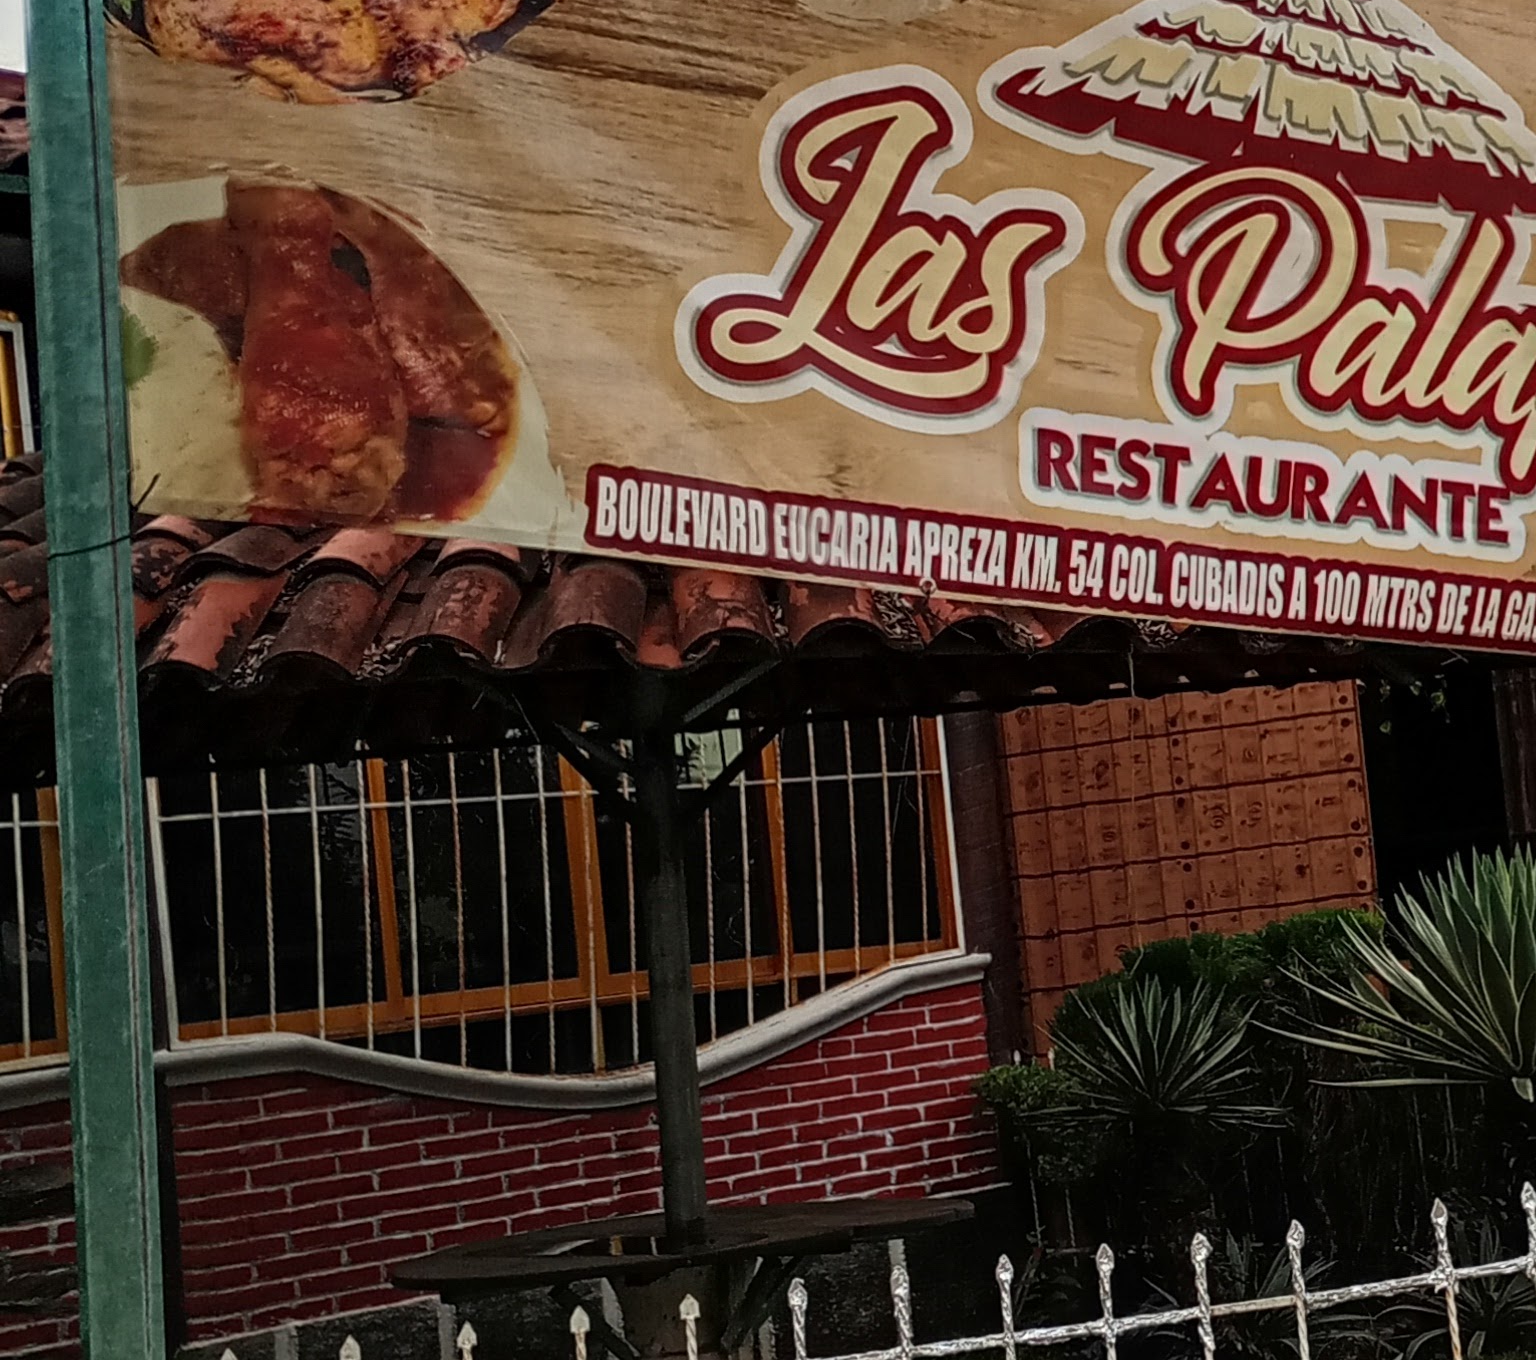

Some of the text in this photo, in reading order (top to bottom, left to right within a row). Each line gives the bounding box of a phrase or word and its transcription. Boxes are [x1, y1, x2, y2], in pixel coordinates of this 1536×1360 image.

[696, 86, 1065, 414] Las
[595, 476, 767, 557] BOULEVARD
[773, 502, 898, 573] EUCARIA
[903, 519, 1007, 587] APREZA
[1012, 533, 1062, 593] KM.
[1067, 540, 1104, 598] 54
[1110, 544, 1164, 605] COL.
[1170, 552, 1284, 618] CUBADIS
[1289, 568, 1310, 621] A
[1313, 568, 1361, 625] 100
[1366, 575, 1434, 634] MTRS
[1438, 584, 1470, 634] DE
[1472, 586, 1502, 639] LA
[1034, 426, 1511, 547] RESTAURANTE
